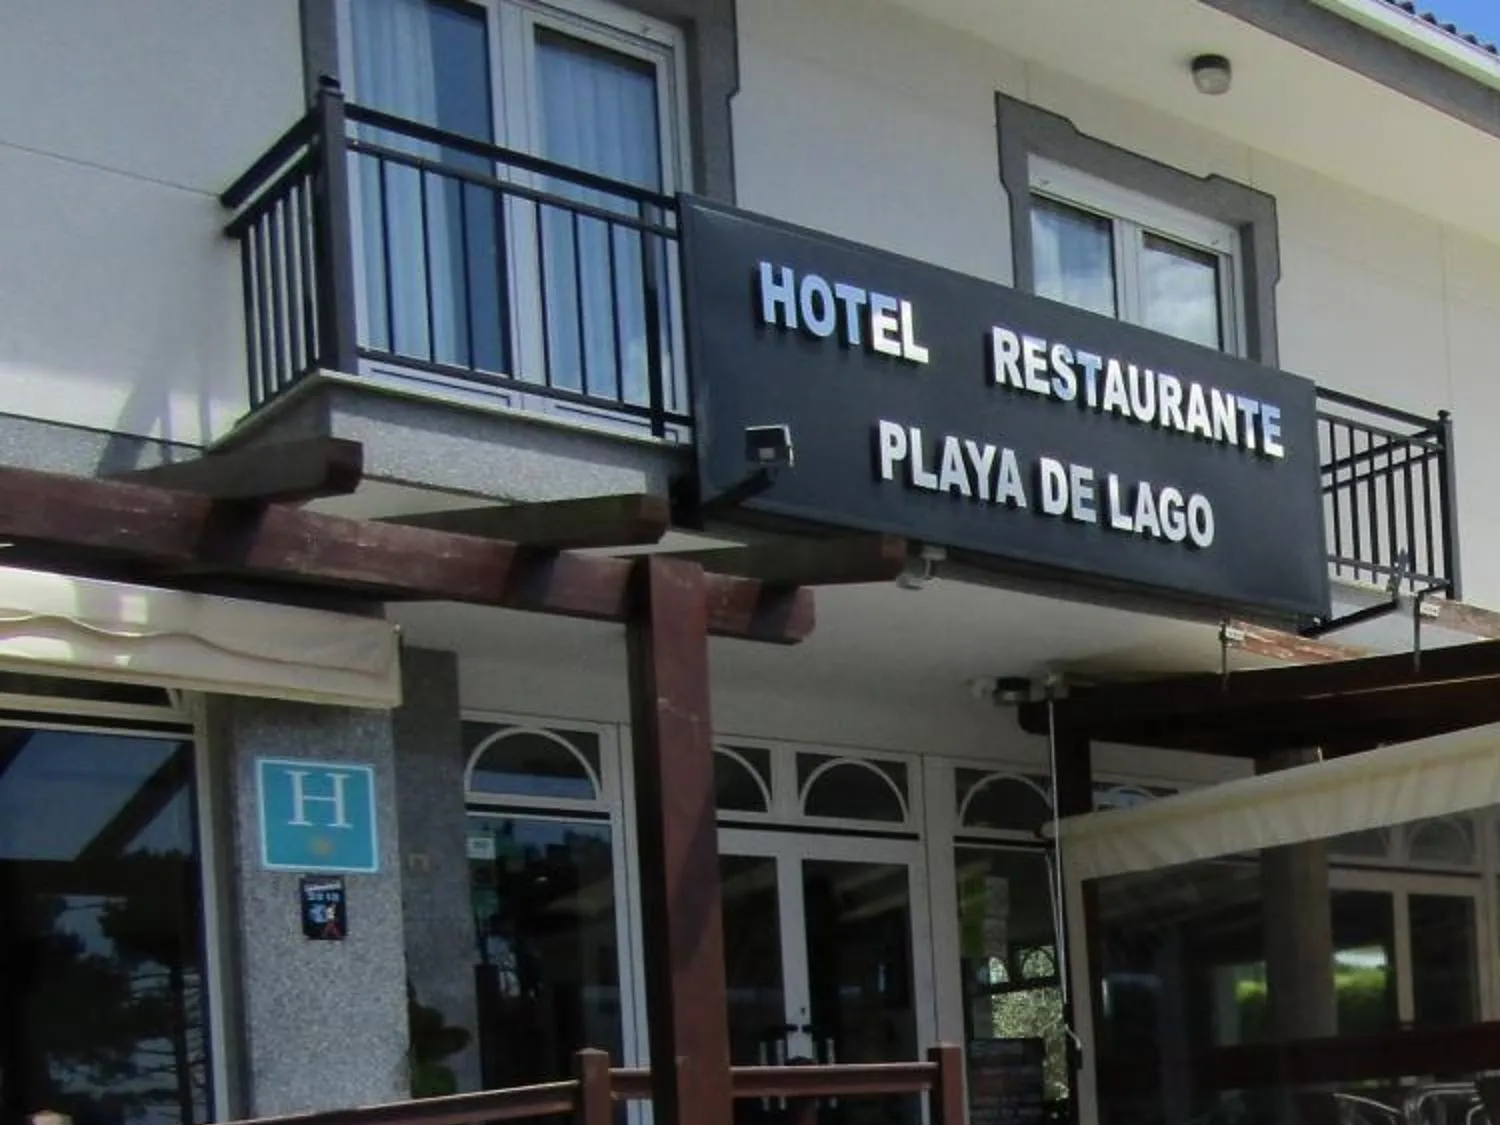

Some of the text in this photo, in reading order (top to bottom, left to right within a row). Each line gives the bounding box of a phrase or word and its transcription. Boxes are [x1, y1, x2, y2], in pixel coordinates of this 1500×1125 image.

[759, 261, 1284, 459] HOTEL RESTAURANTE
[878, 419, 1216, 549] PLAYA DE LAGO
[286, 769, 353, 829] H
